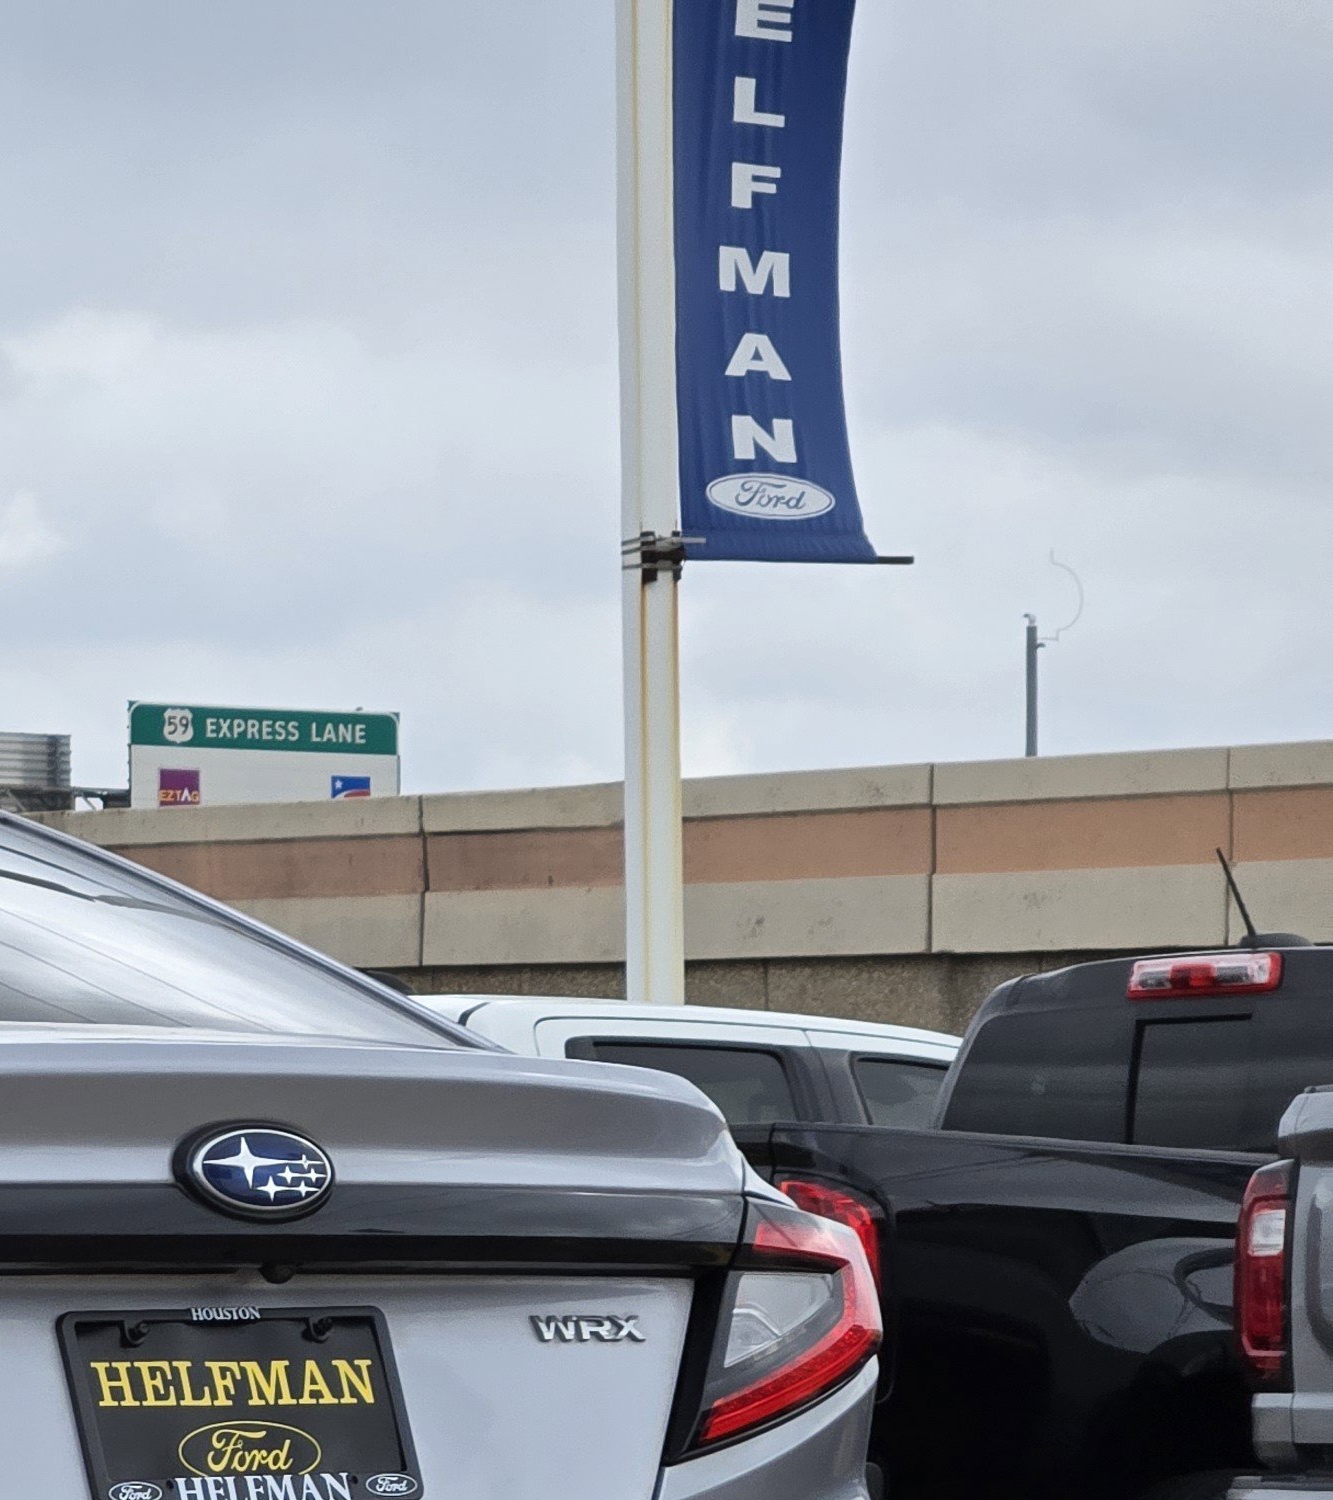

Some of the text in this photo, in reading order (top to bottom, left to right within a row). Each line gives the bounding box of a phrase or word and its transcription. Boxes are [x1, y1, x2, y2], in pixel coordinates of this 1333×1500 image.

[733, 479, 806, 512] Ford
[166, 715, 367, 744] 59 EXPRESS LANE
[191, 1306, 261, 1321] HOUSTON
[528, 1315, 646, 1342] WRX
[90, 1358, 376, 1408] HELFMAN
[206, 1427, 294, 1473] Ford
[373, 1474, 409, 1494] Ford
